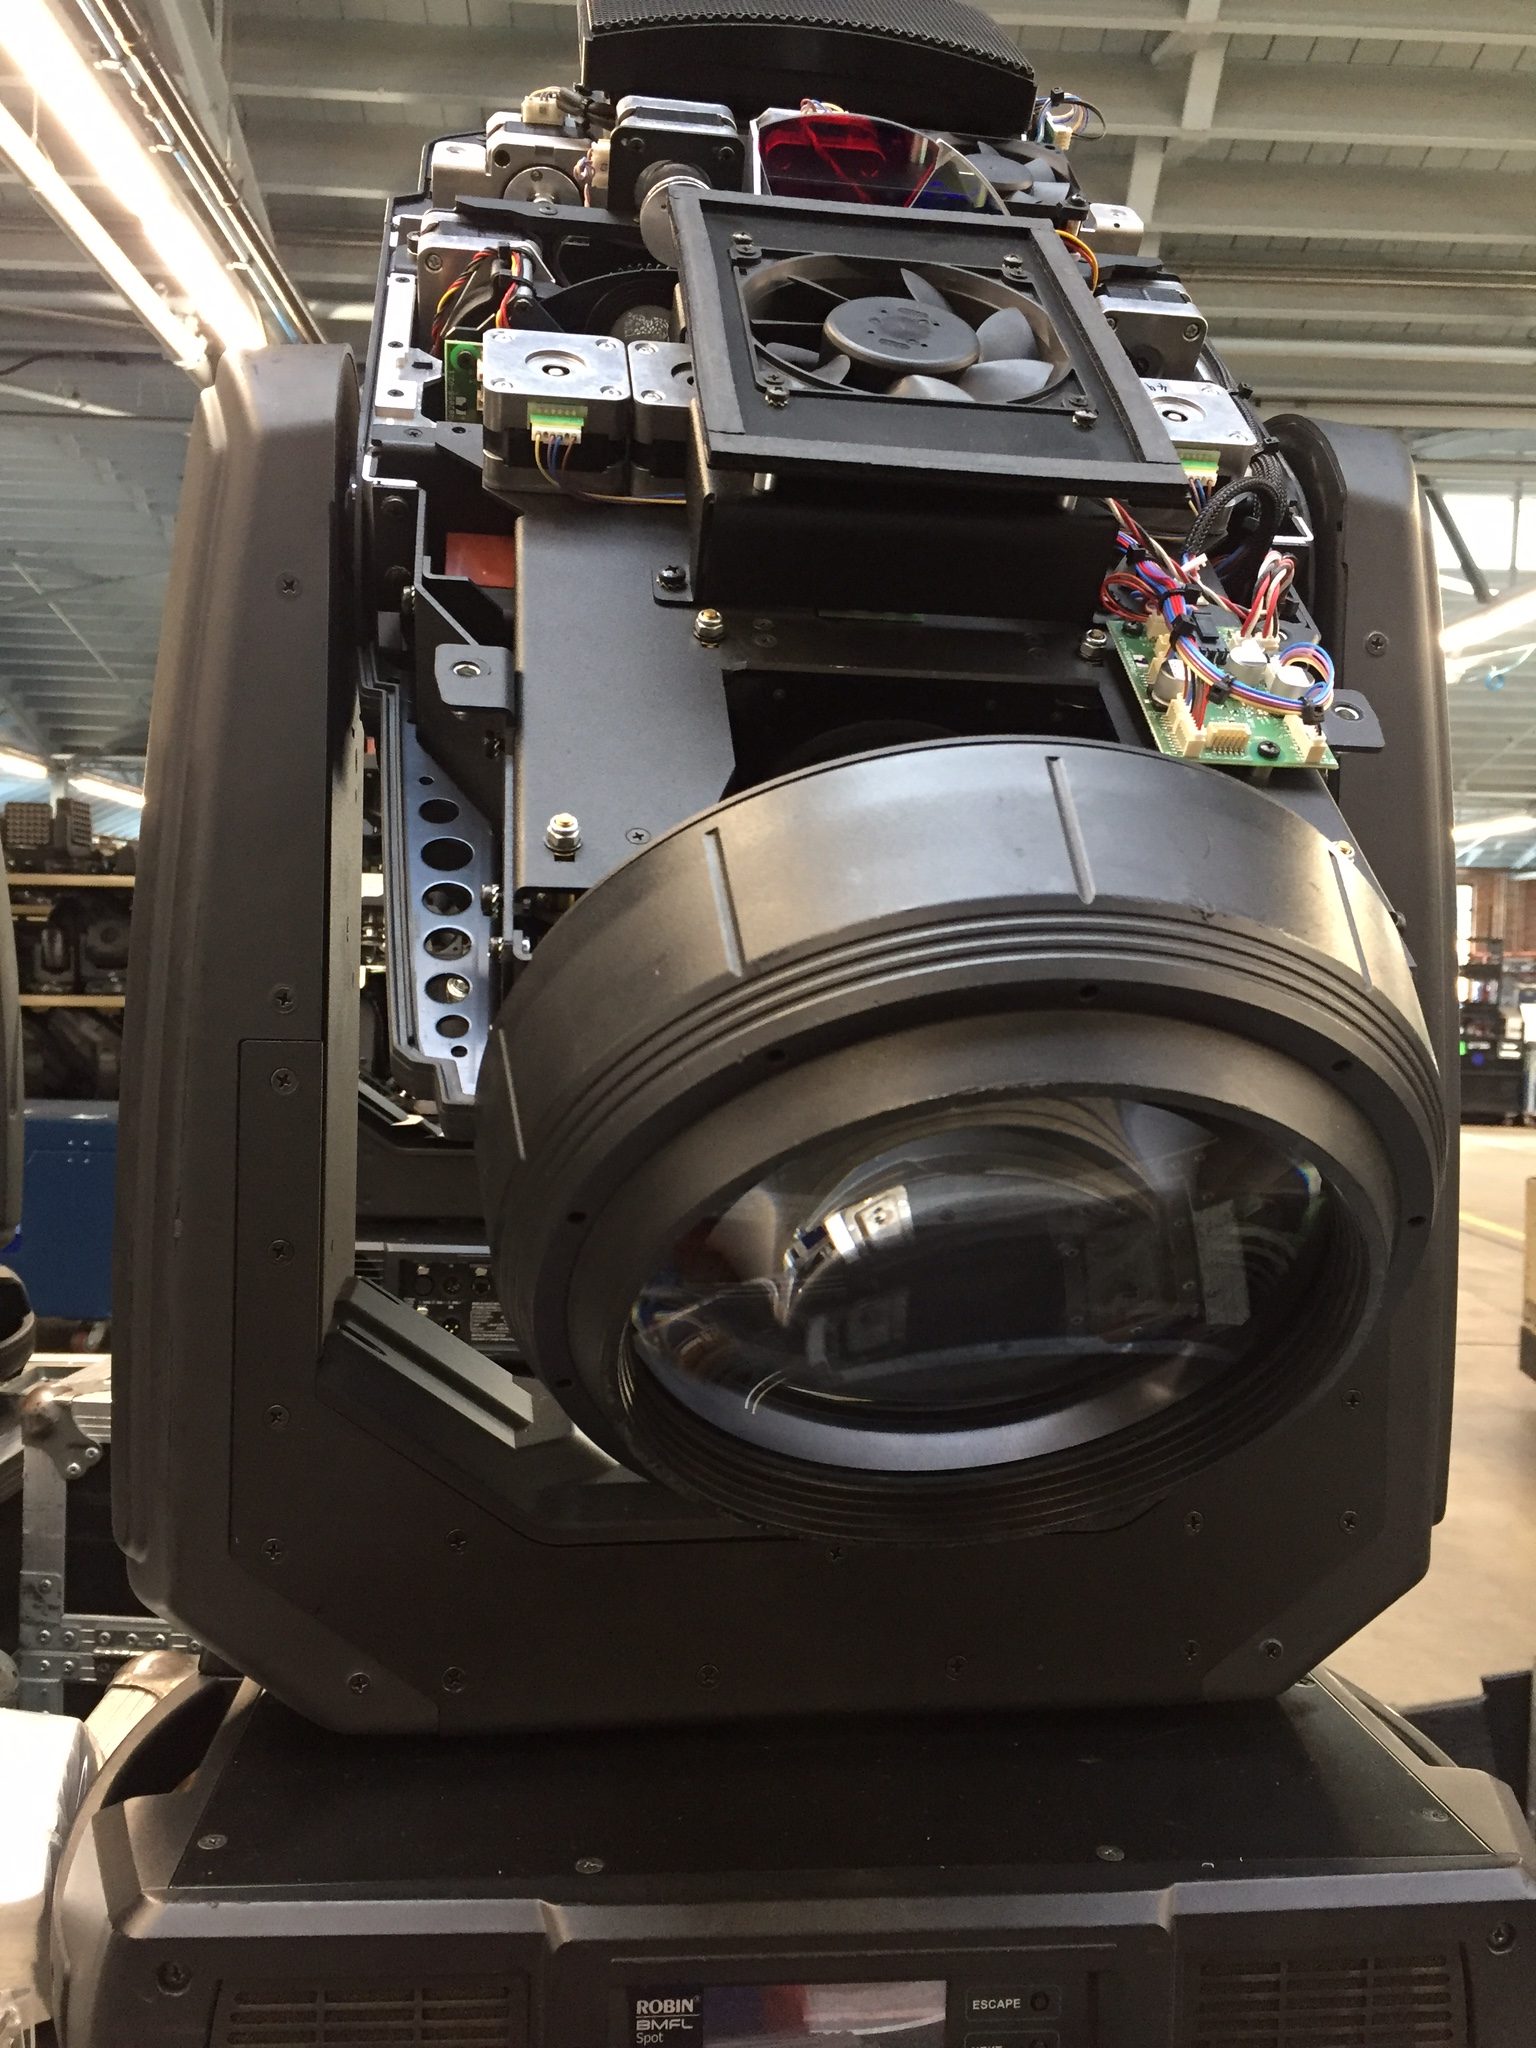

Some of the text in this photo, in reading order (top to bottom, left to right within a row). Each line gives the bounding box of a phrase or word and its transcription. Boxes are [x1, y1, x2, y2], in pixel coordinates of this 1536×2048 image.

[636, 1998, 694, 2015] ROBIN
[972, 1998, 1021, 2010] ESCAPE
[636, 2018, 693, 2031] BMFL
[636, 2032, 664, 2046] Spot
